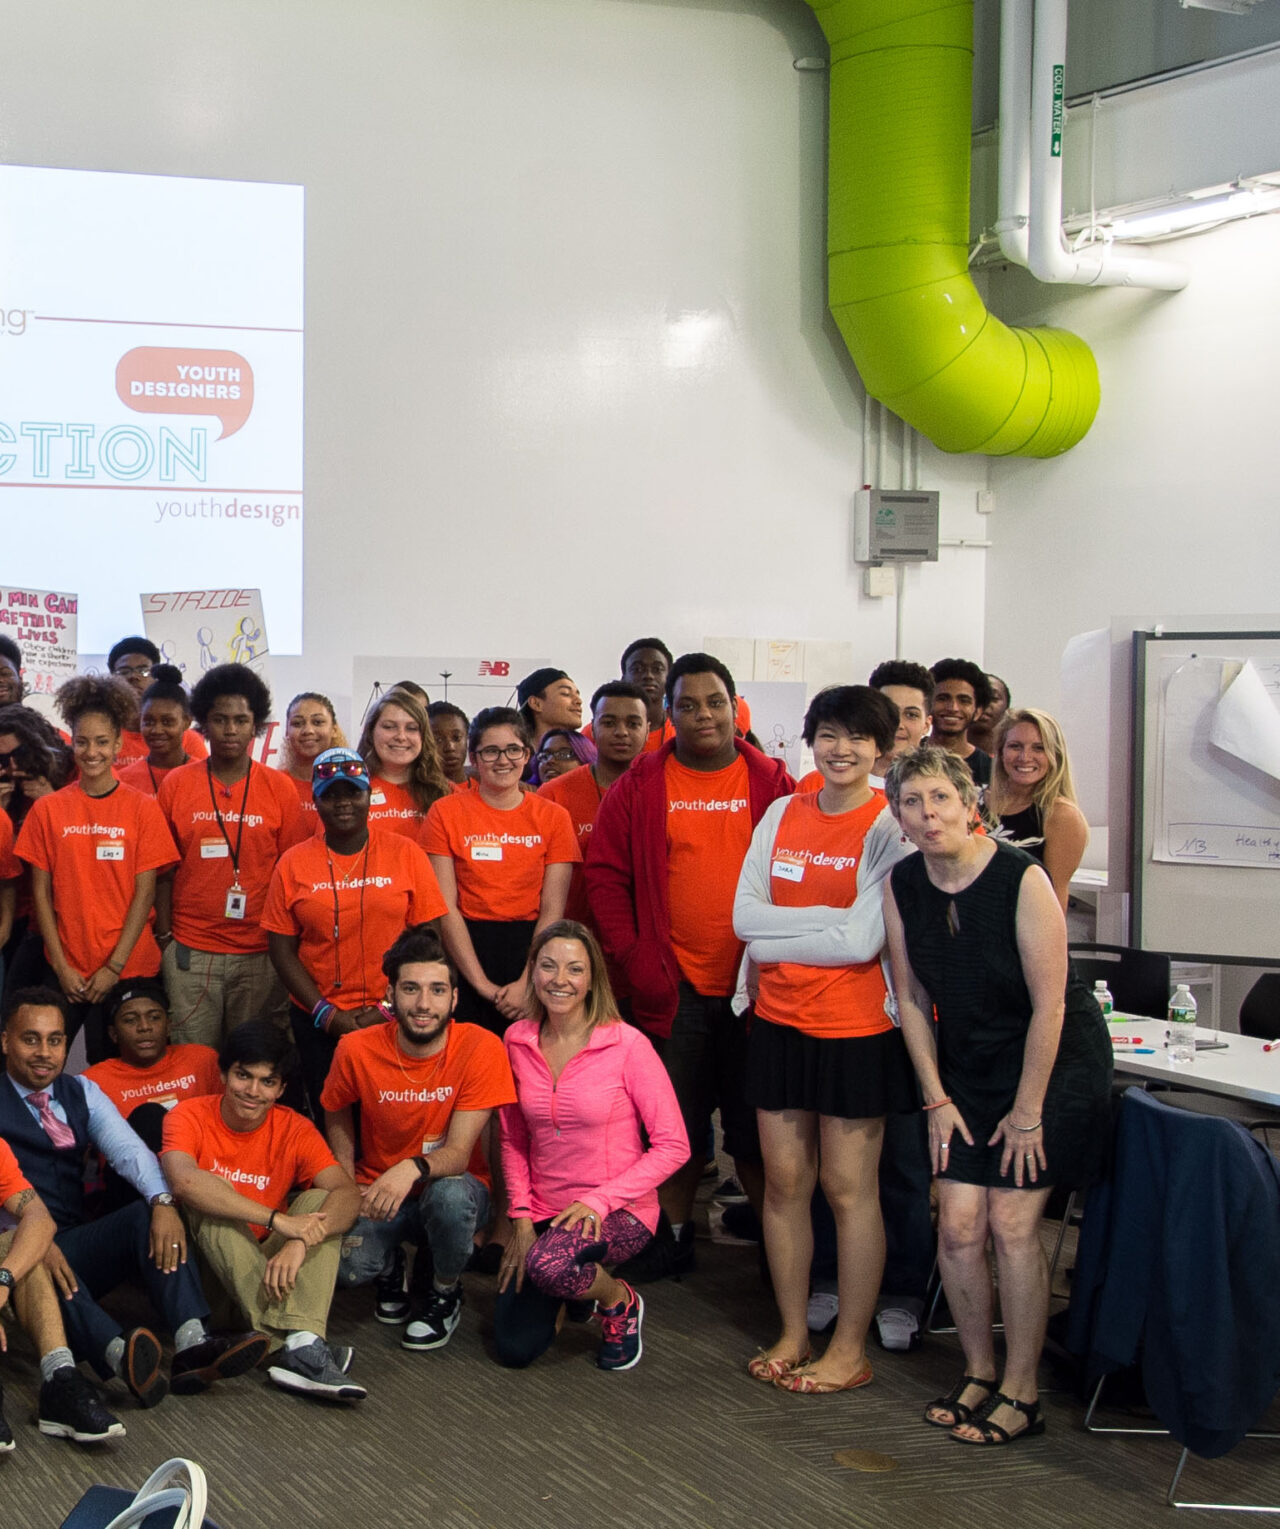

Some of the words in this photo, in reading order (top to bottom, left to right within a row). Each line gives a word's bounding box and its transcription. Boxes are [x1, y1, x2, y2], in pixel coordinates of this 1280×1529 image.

[1054, 68, 1063, 95] COLD
[1052, 100, 1063, 134] WATER
[177, 365, 241, 383] YOUTH
[130, 381, 241, 400] DESIGNERS
[154, 497, 301, 526] youthdesign
[8, 591, 39, 608] MIN
[44, 593, 77, 614] CAN
[144, 589, 254, 613] STRIDE
[17, 627, 58, 644] LIVES
[477, 660, 510, 677] NB
[668, 798, 747, 813] youthdesign
[463, 832, 542, 848] youthdesign
[771, 847, 856, 871] youthdesign
[312, 876, 392, 893] youthdesign
[121, 1074, 196, 1102] youthdesign
[378, 1085, 453, 1104] youthdsgn
